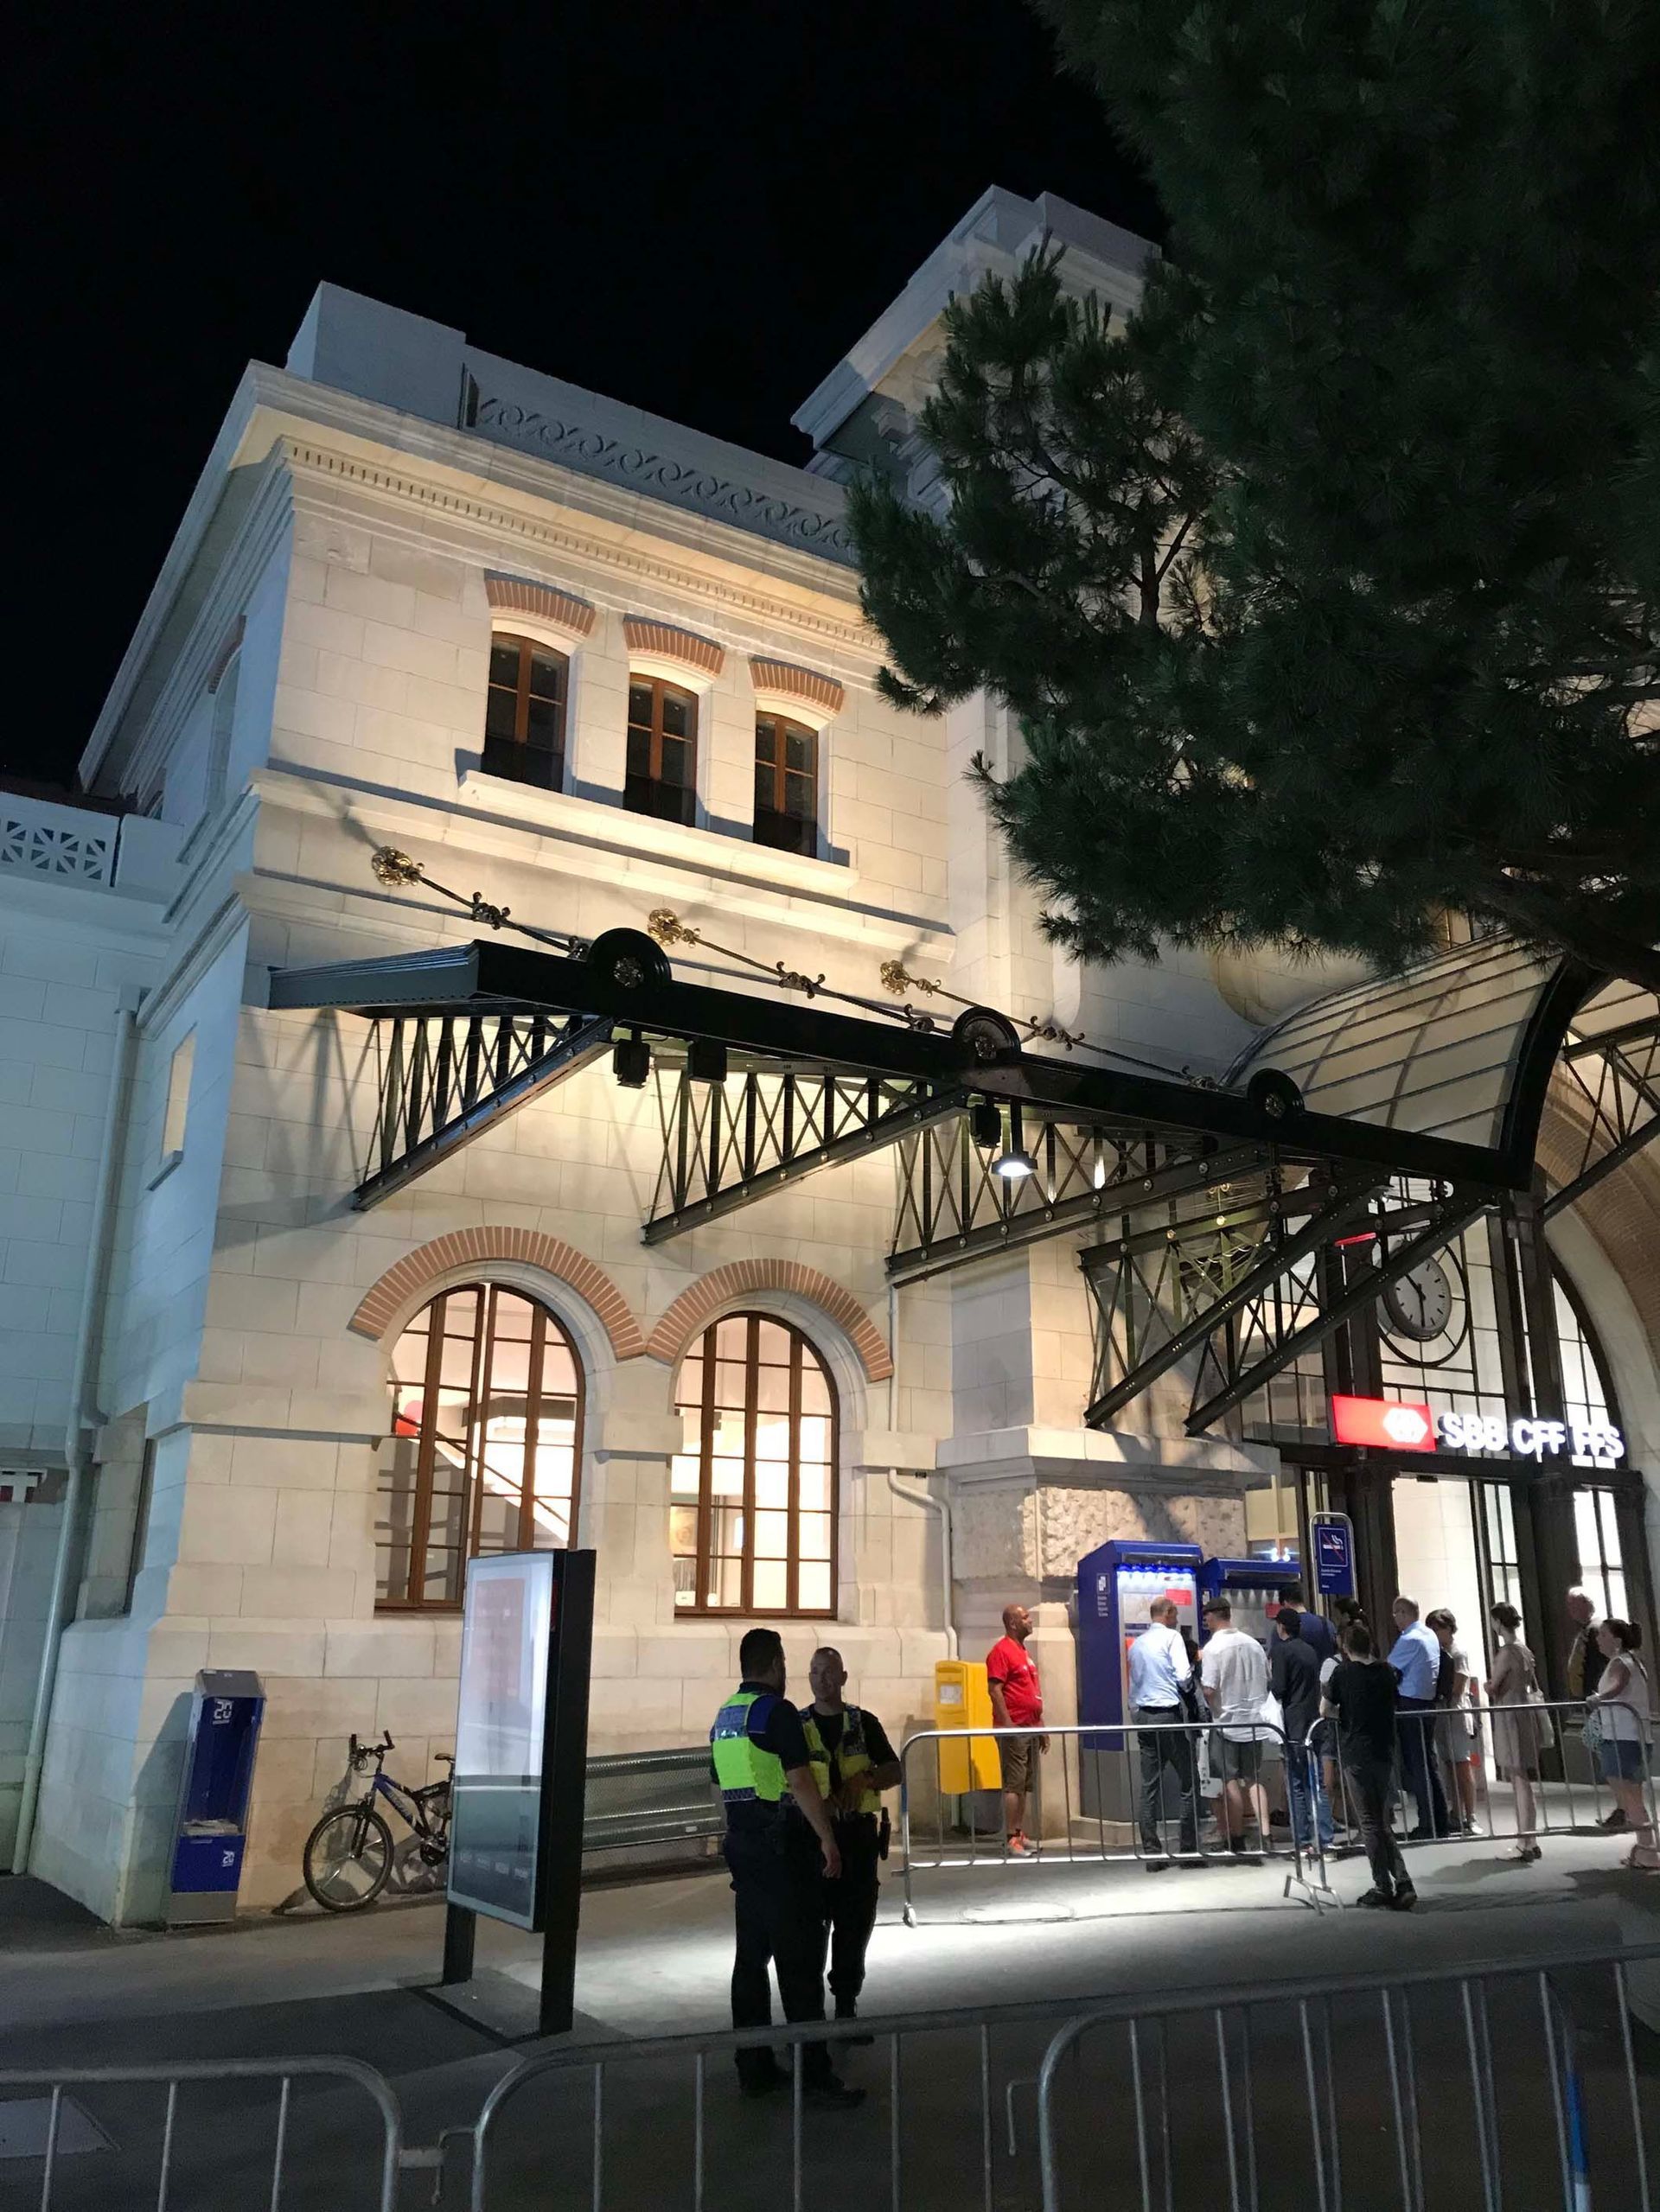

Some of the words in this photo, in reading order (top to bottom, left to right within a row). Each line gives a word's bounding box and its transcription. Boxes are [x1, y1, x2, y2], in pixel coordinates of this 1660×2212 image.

[1440, 1412, 1503, 1451] SBB
[1511, 1418, 1567, 1455] CFF
[1572, 1425, 1625, 1458] FFS
